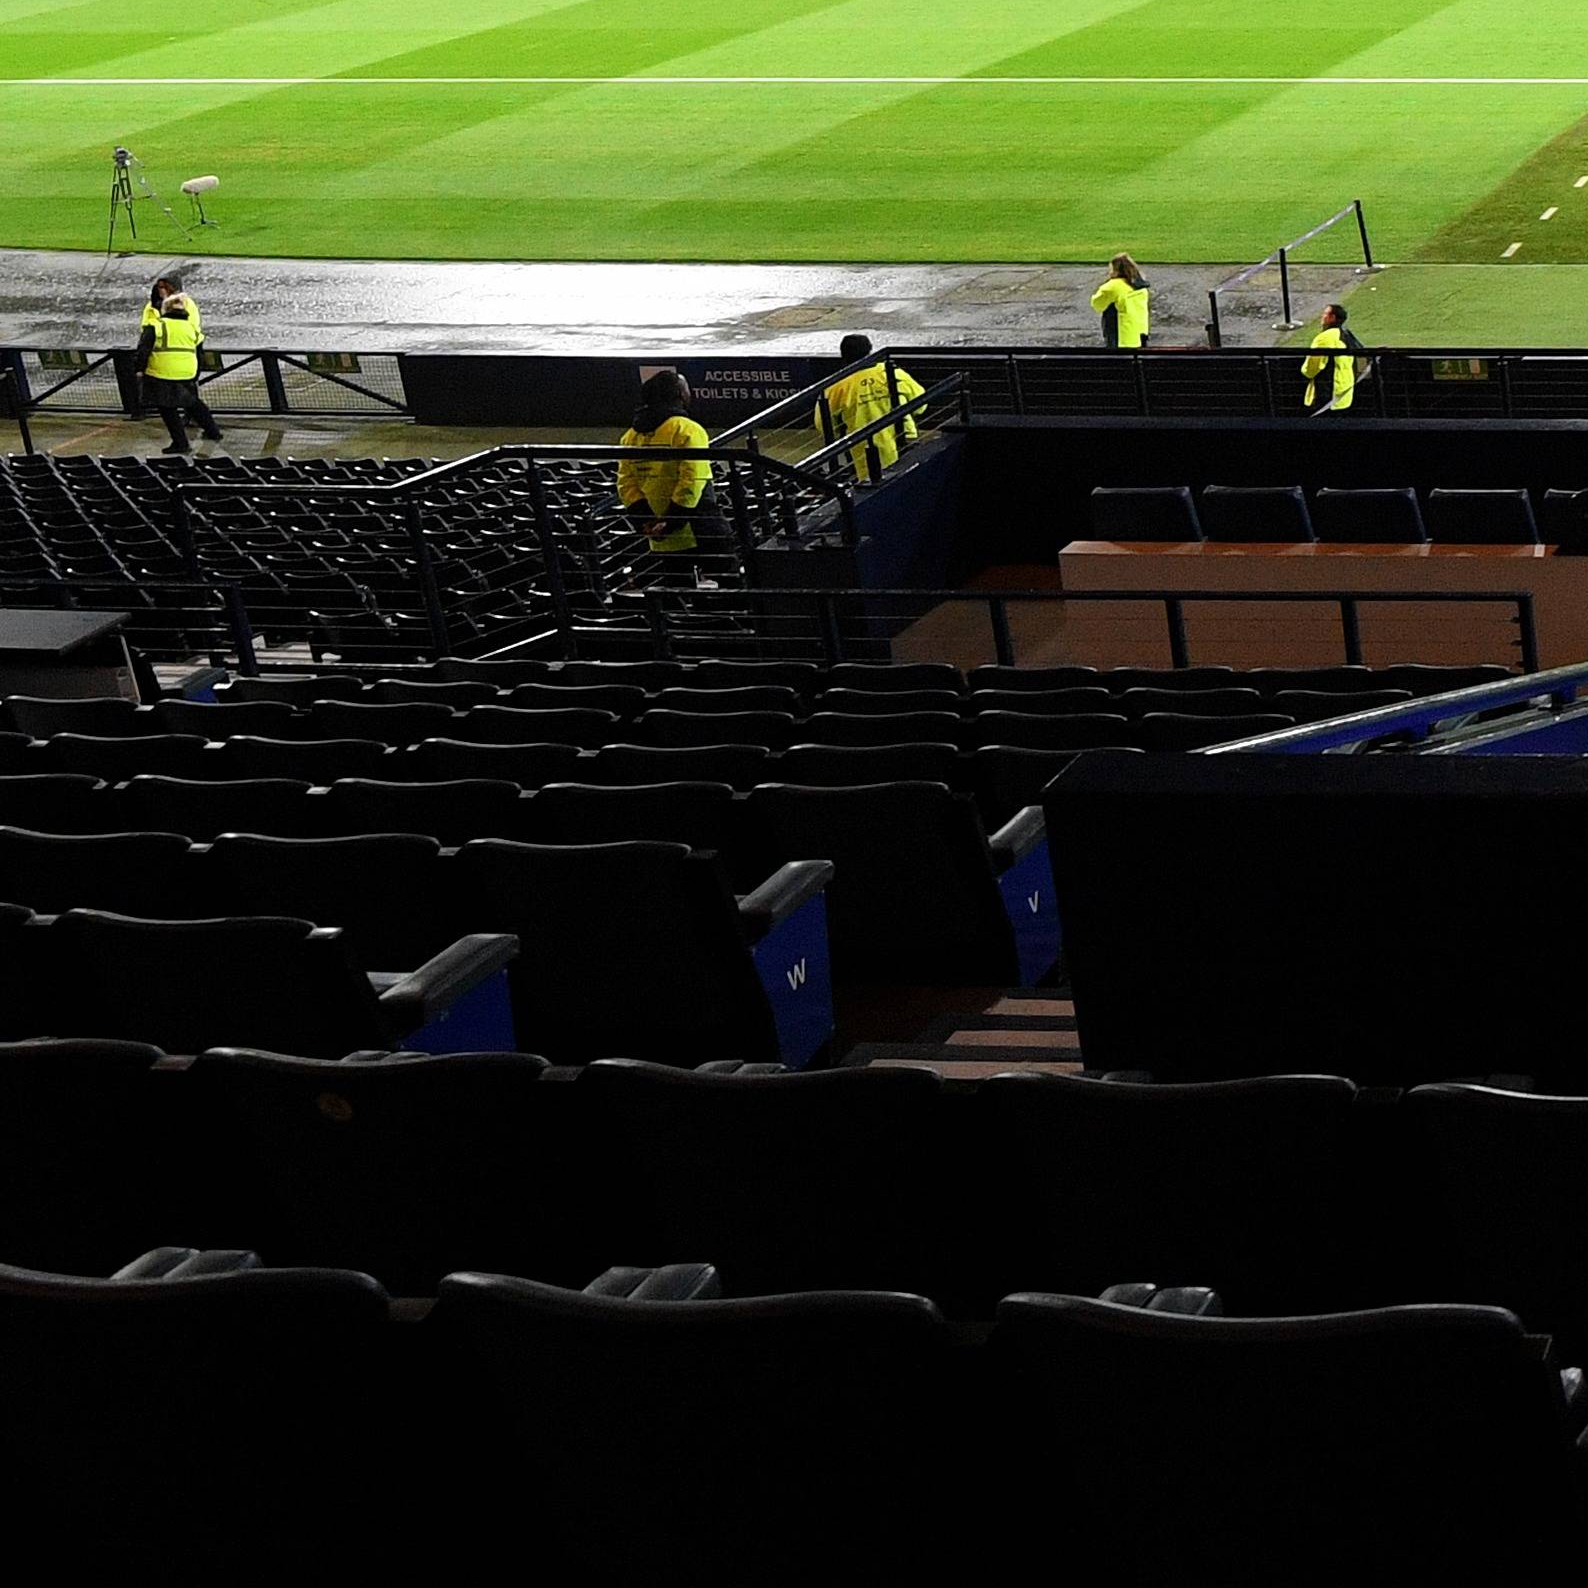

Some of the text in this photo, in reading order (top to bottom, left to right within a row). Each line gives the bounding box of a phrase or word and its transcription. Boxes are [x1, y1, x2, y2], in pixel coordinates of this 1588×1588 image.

[704, 370, 791, 382] ACCESSIBLE
[693, 387, 801, 400] TOILETS & KIOS
[1027, 890, 1039, 914] V
[786, 956, 804, 990] W
